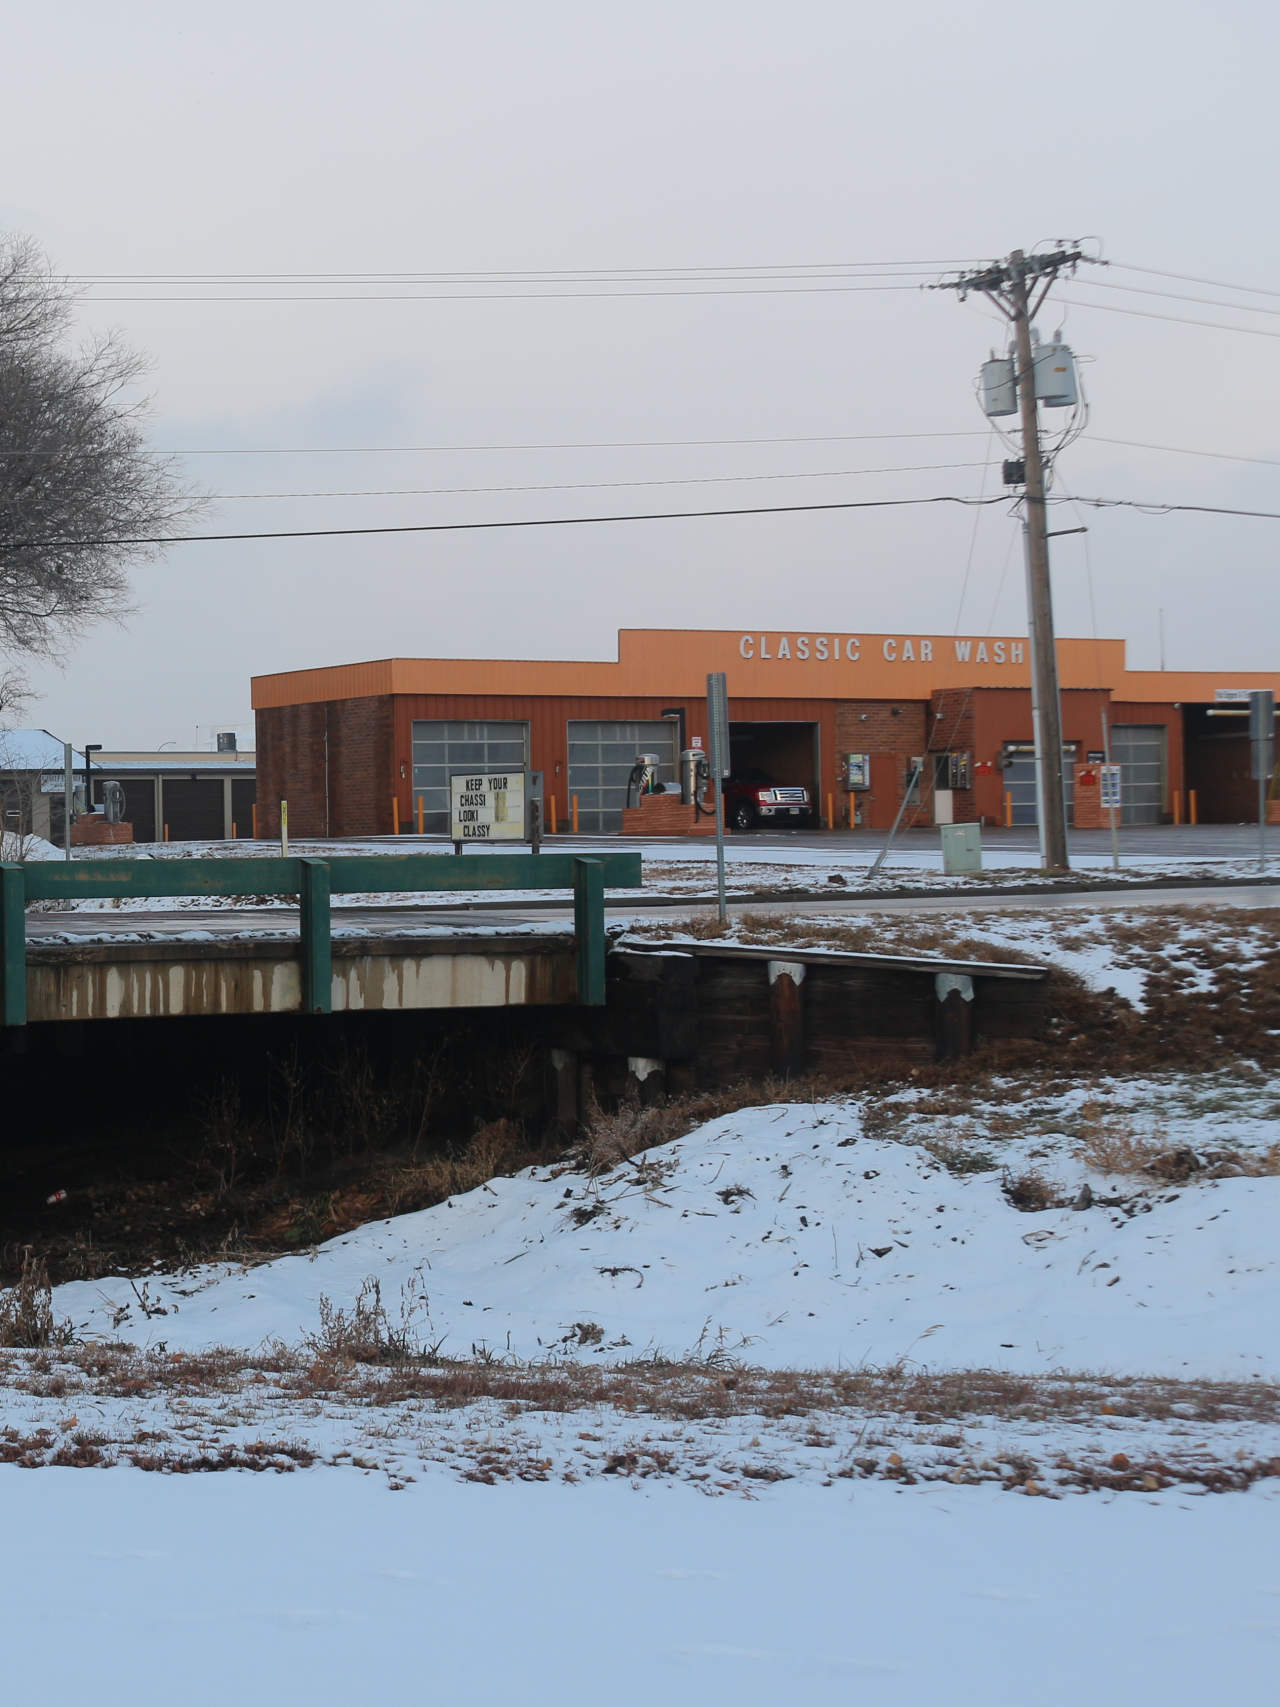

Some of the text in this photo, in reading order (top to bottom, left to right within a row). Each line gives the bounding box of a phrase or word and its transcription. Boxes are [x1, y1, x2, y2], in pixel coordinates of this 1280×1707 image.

[739, 635, 1024, 664] CLASSIC CAR WASH
[466, 777, 507, 791] KEEP YOUR
[460, 794, 486, 807] CHASSI
[463, 825, 490, 837] CLASSY
